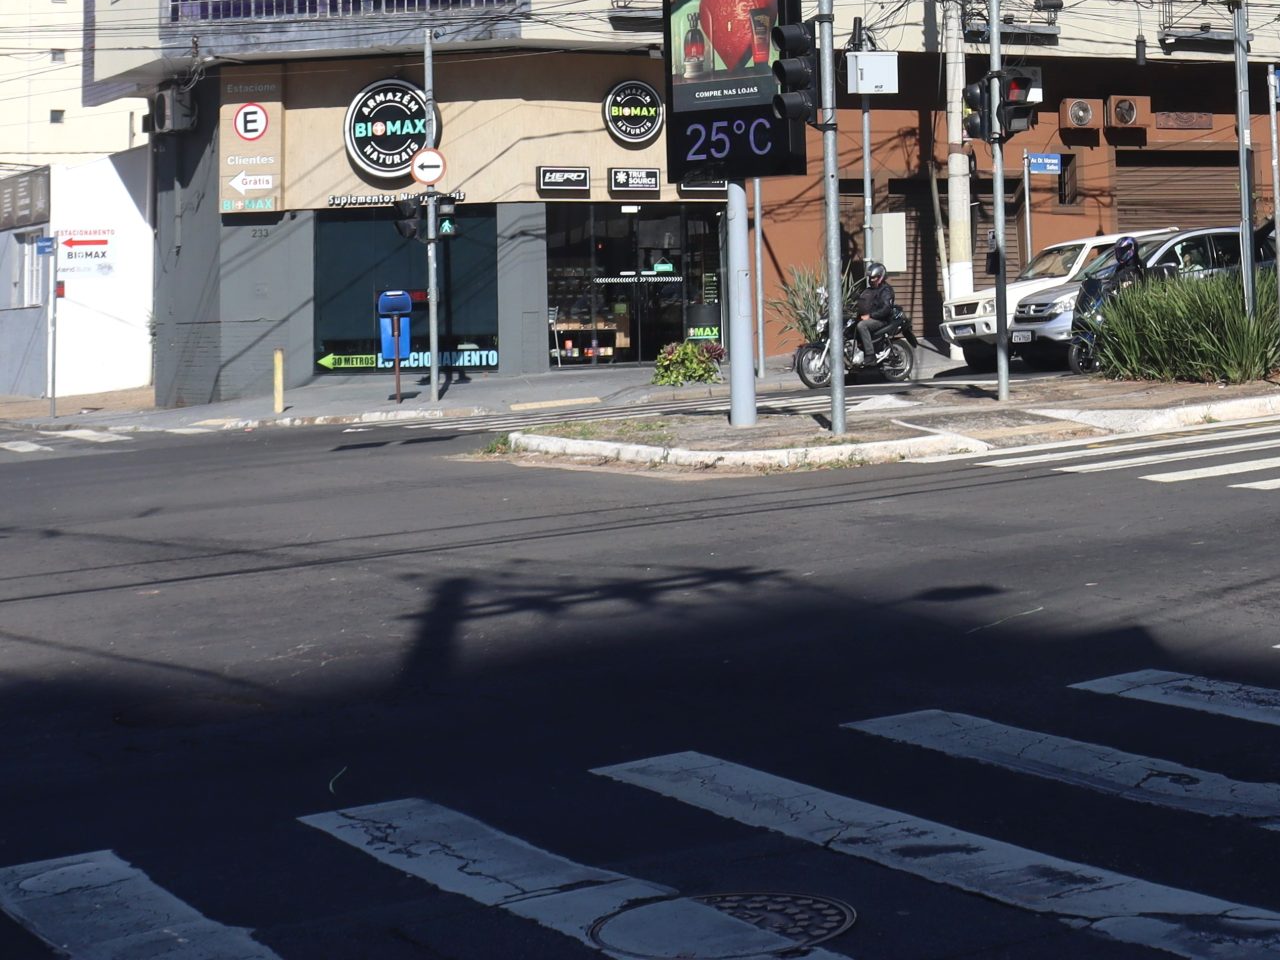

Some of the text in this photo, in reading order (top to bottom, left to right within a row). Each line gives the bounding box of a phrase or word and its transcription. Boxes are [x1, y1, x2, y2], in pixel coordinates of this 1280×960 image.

[226, 83, 276, 93] Estacione
[695, 86, 758, 98] COMPRE NAS LOJAS
[361, 92, 420, 117] ARMAZÉM
[243, 111, 259, 134] E
[617, 121, 652, 135] NATURAIS
[363, 141, 420, 165] NATURAIS
[226, 155, 275, 166] Clientes
[545, 172, 585, 184] HERO
[629, 177, 656, 185] SOURCE
[328, 193, 397, 208] Suplementos
[252, 229, 269, 239] 233
[332, 356, 342, 366] 30
[343, 356, 375, 366] METROS
